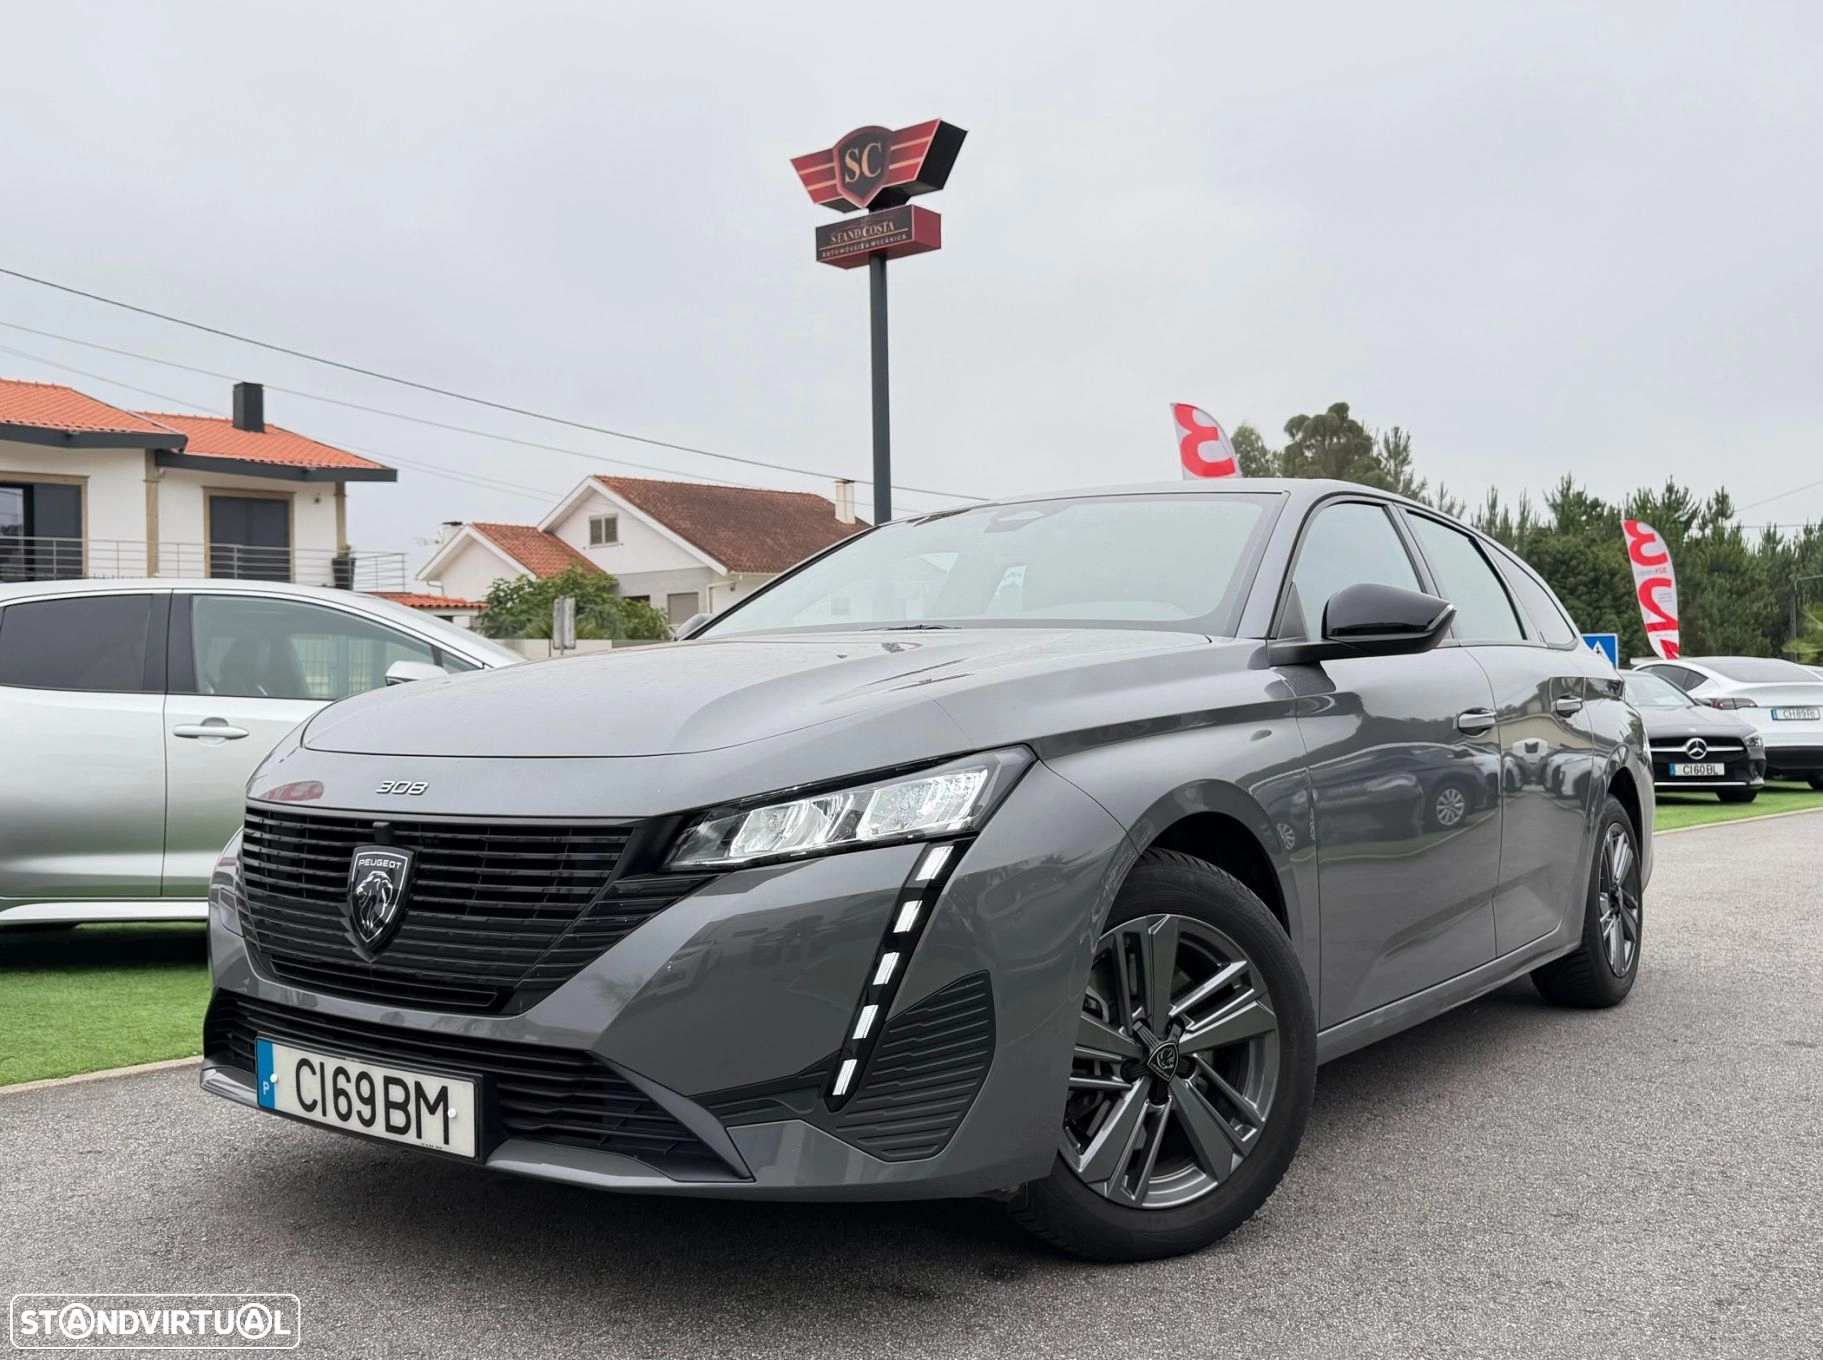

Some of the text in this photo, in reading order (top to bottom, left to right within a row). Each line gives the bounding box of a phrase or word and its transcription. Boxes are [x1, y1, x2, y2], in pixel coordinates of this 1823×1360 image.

[845, 142, 883, 183] SC
[831, 221, 895, 244] STAND COSTA
[375, 780, 429, 795] 308
[358, 858, 402, 869] PEUGEOT
[262, 1081, 270, 1095] P
